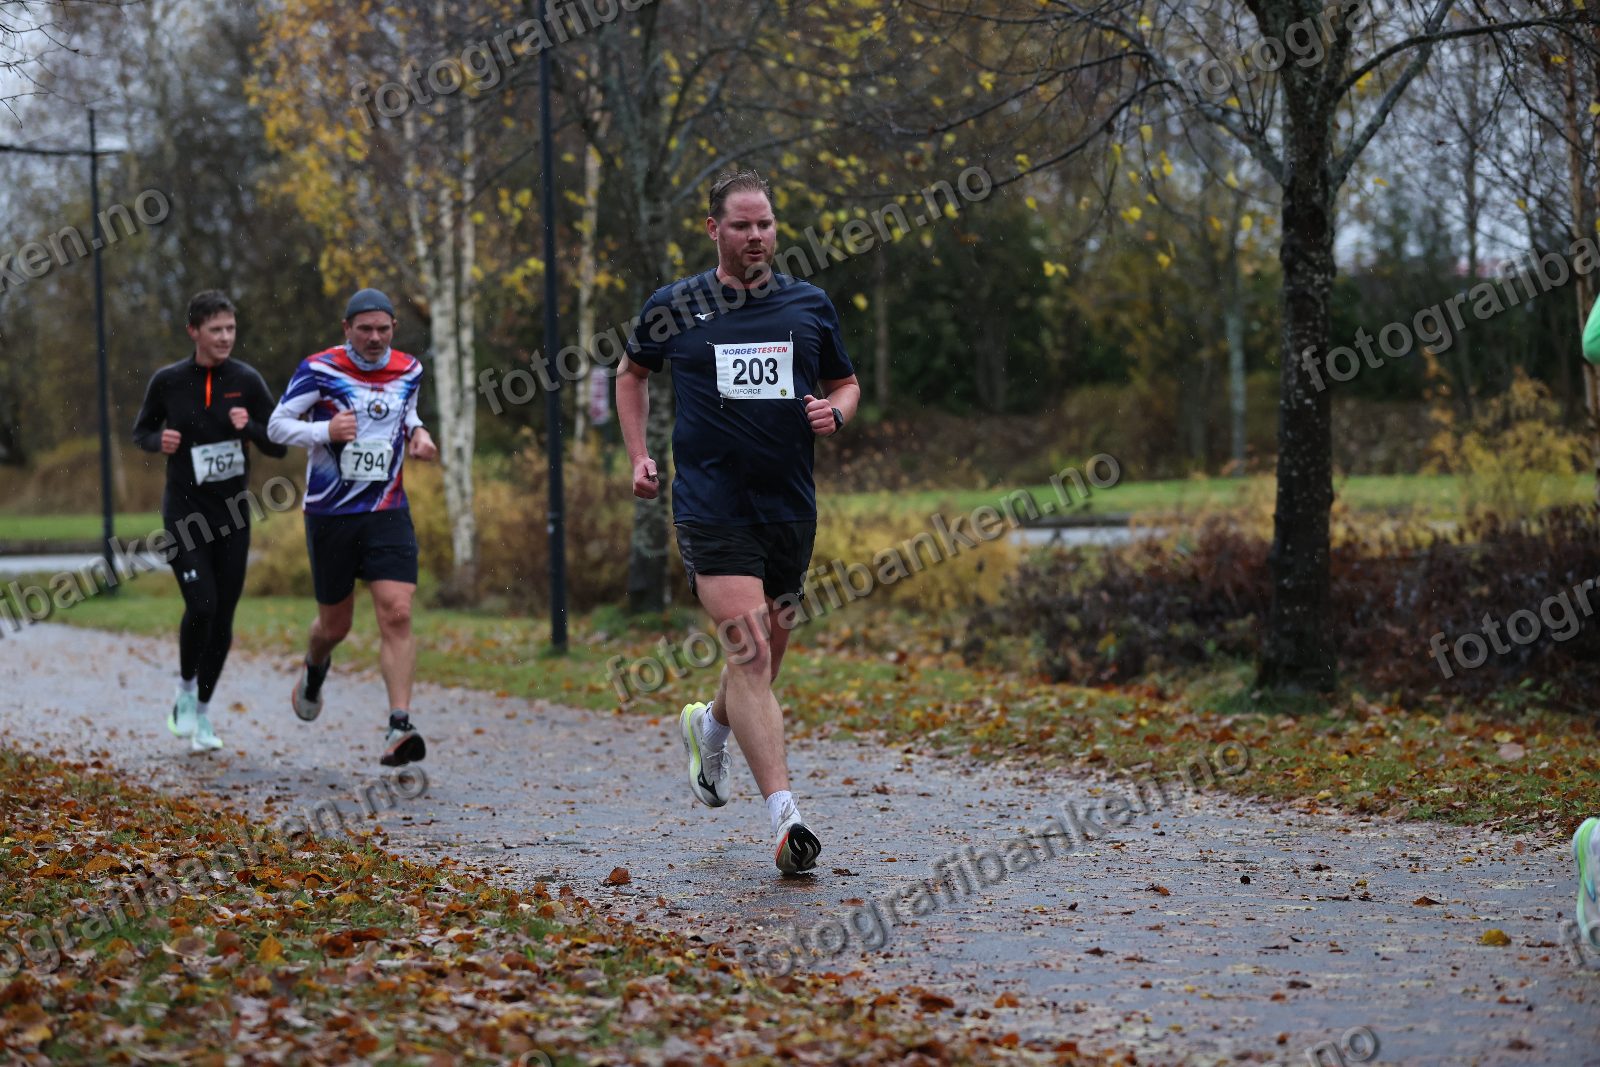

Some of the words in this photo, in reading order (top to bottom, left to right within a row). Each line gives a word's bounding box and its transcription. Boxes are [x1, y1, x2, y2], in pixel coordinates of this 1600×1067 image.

[722, 346, 788, 355] NORGESTESTEN
[732, 357, 779, 385] 203
[204, 452, 234, 476] 767
[352, 451, 385, 472] 794
